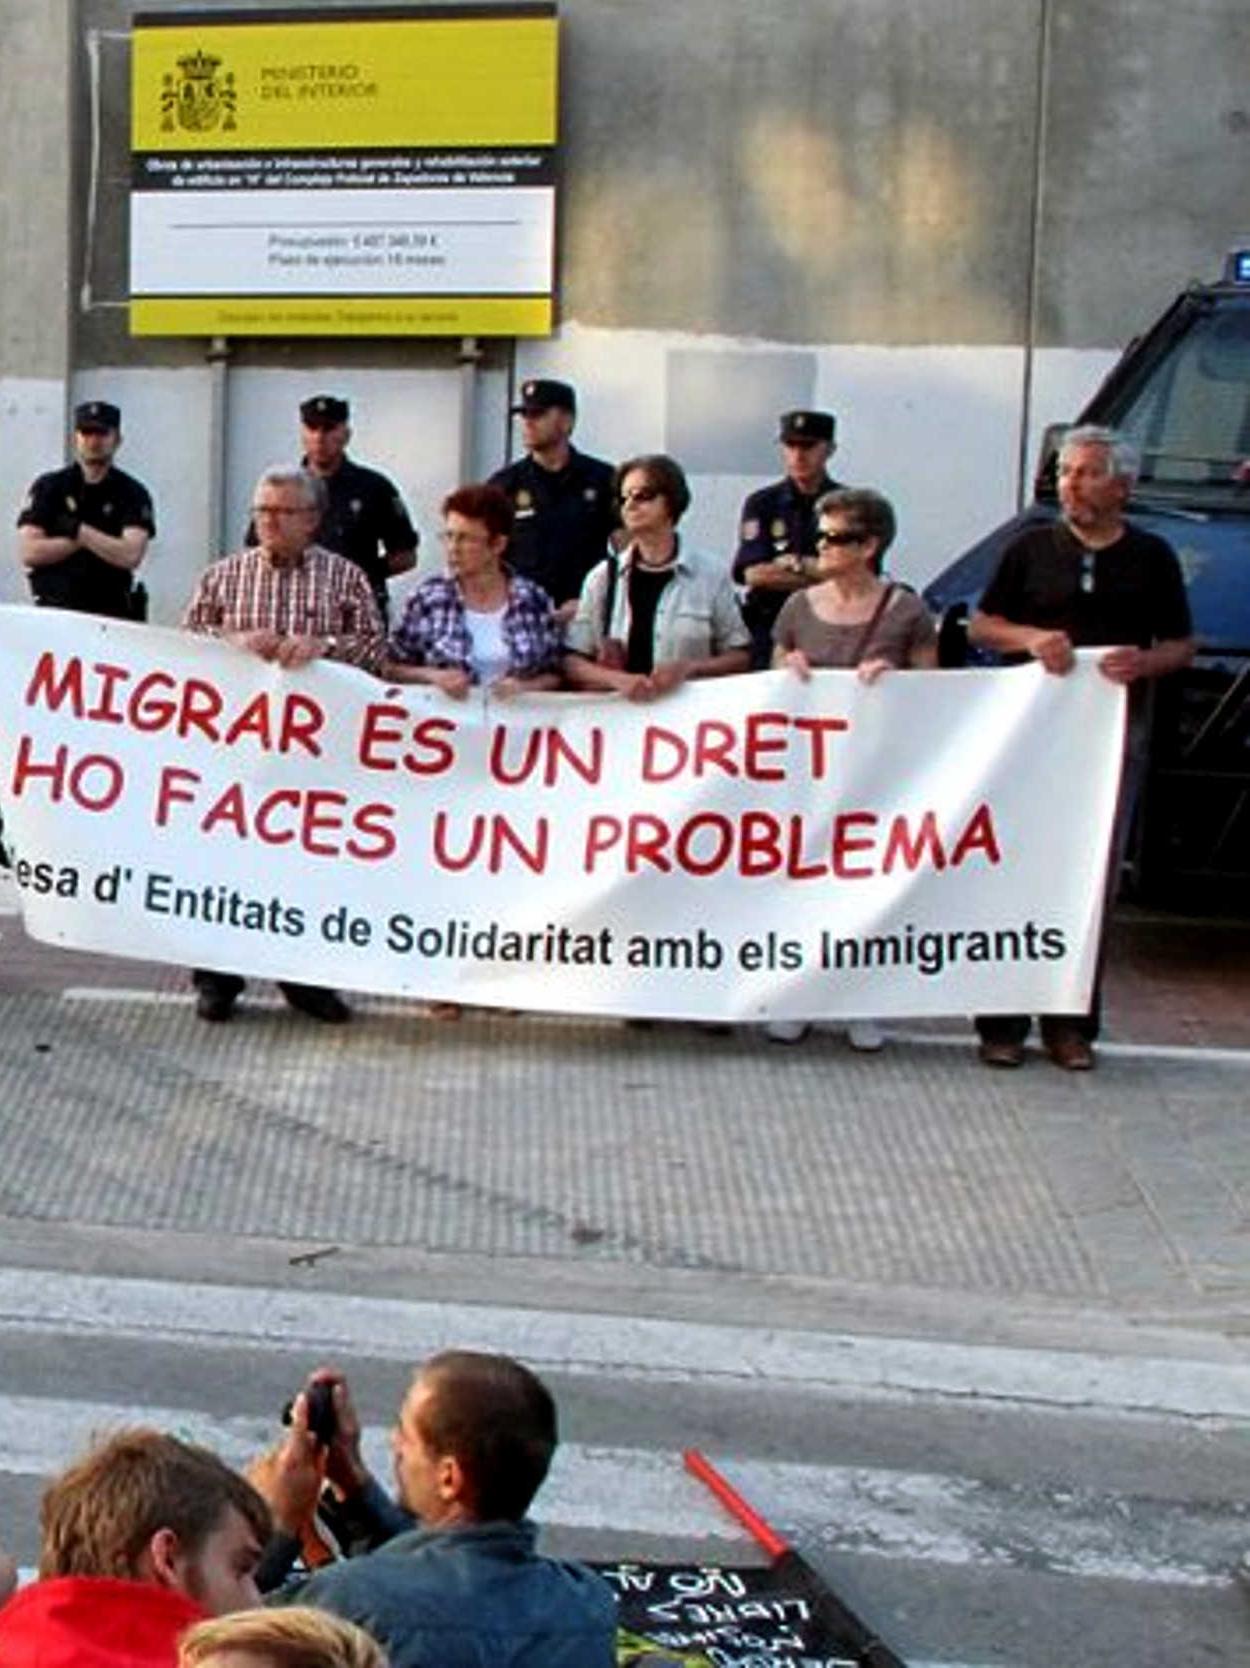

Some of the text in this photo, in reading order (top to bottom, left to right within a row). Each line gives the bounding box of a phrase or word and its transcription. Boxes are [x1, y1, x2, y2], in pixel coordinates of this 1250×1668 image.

[260, 65, 359, 81] MINISTERIO
[260, 82, 377, 99] DEL INTERIOR
[25, 651, 849, 788] MIGRAR ÉS UN DRET
[11, 735, 125, 813] HO
[156, 765, 398, 860] FACES
[432, 810, 549, 875] UN
[584, 803, 1001, 881] PROBLEMA
[11, 848, 1068, 975] esa d' Entitats de Solidaritat amb els Inmigrants
